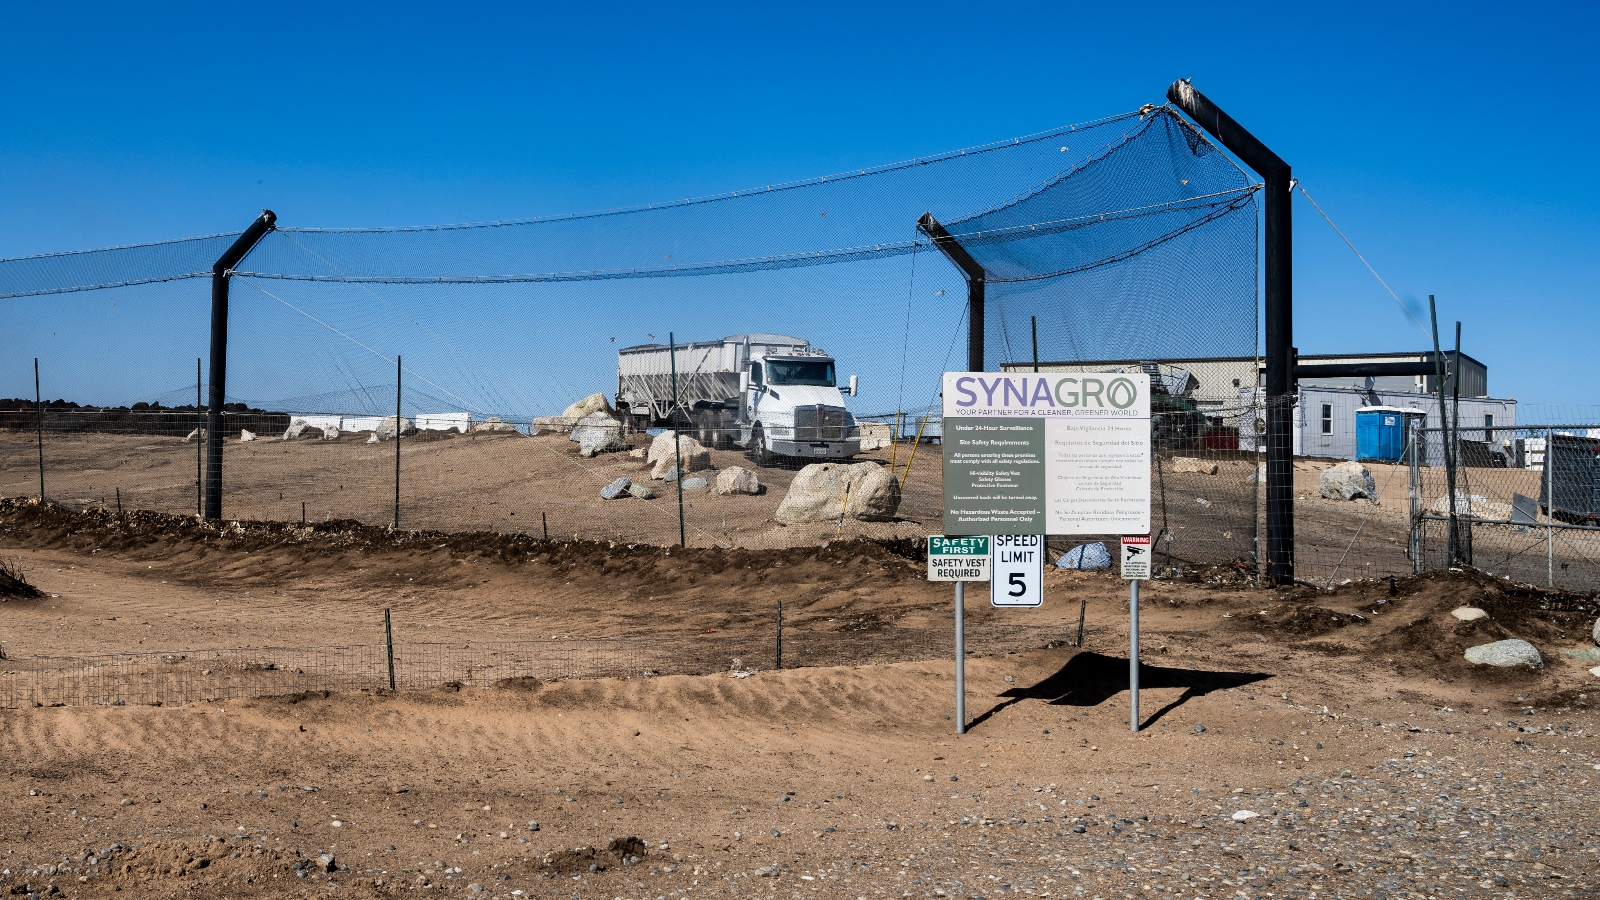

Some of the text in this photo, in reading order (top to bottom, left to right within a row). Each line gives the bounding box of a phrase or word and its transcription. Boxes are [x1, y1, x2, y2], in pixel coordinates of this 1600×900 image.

[955, 376, 1138, 409] SYNAGRO
[933, 538, 985, 548] SAFETY
[997, 535, 1038, 547] SPEED
[932, 559, 986, 567] SAFETY VEST
[1002, 551, 1034, 563] LIMIT
[938, 569, 980, 578] REQUIRED
[1008, 573, 1027, 597] 5
